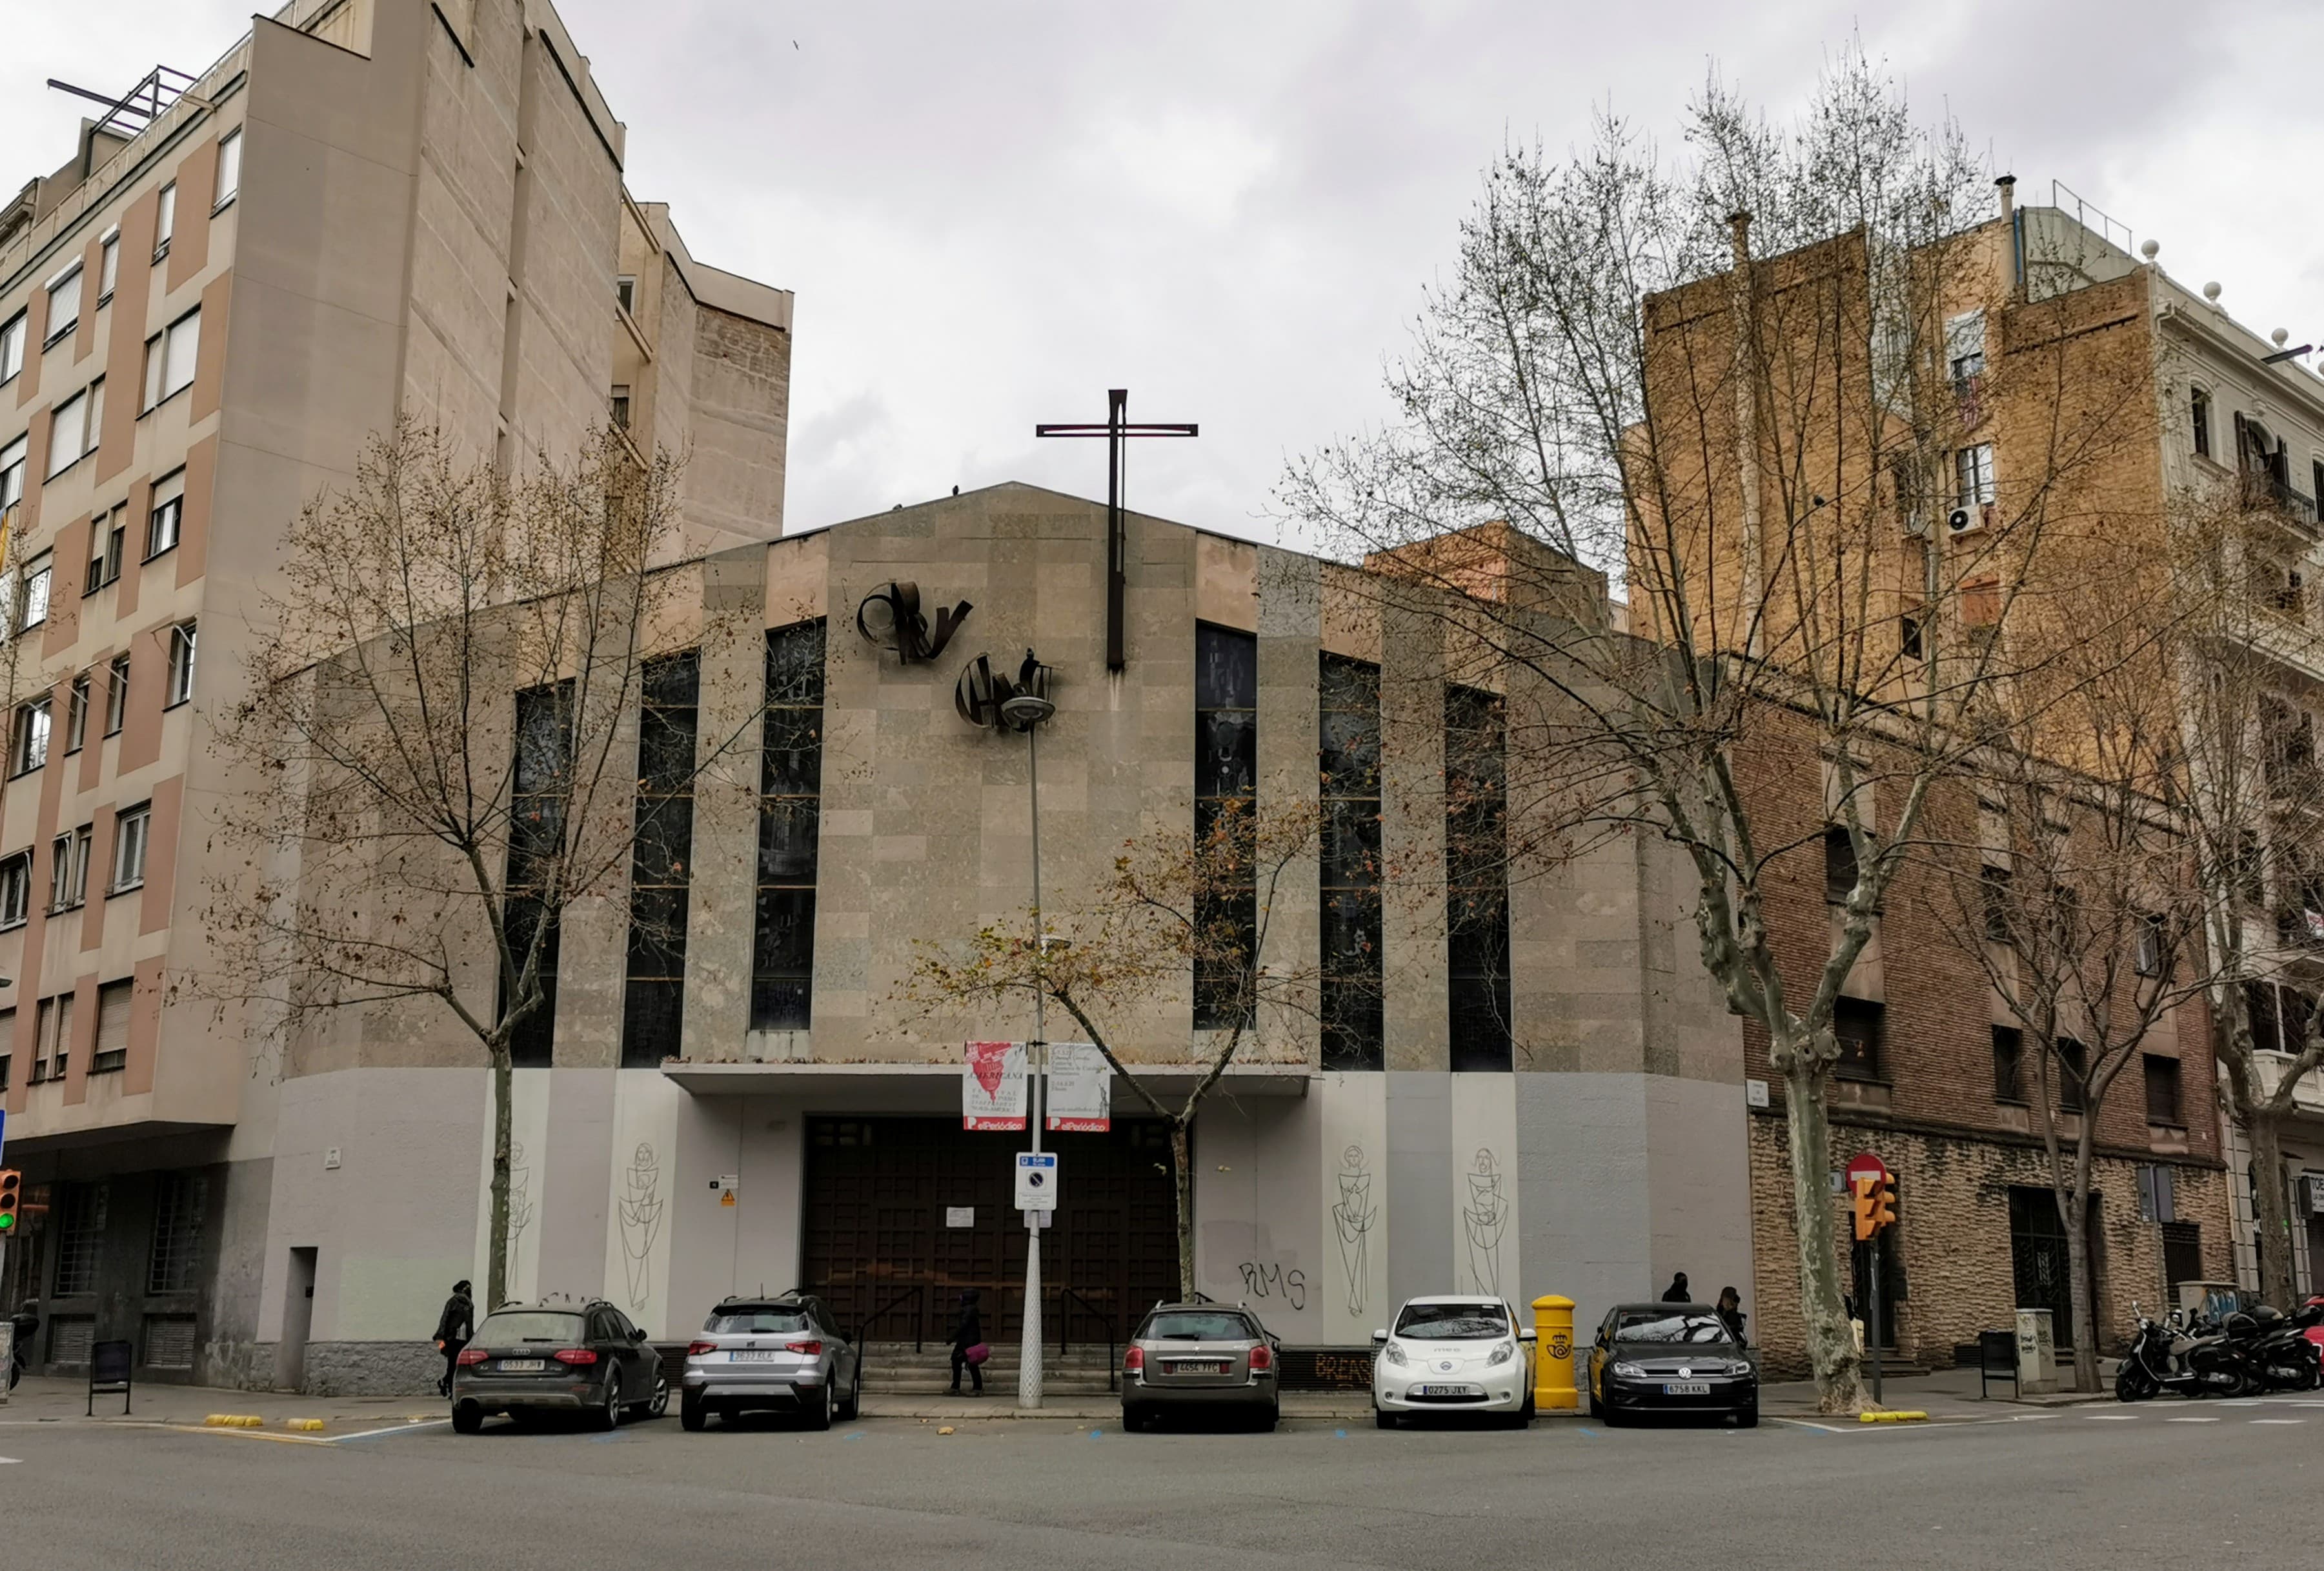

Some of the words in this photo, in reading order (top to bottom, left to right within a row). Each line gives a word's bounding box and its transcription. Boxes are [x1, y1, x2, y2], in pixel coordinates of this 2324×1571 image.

[1238, 1263, 1306, 1311] RMS
[1428, 1386, 1449, 1394] 0275
[1669, 1385, 1690, 1394] 6758
